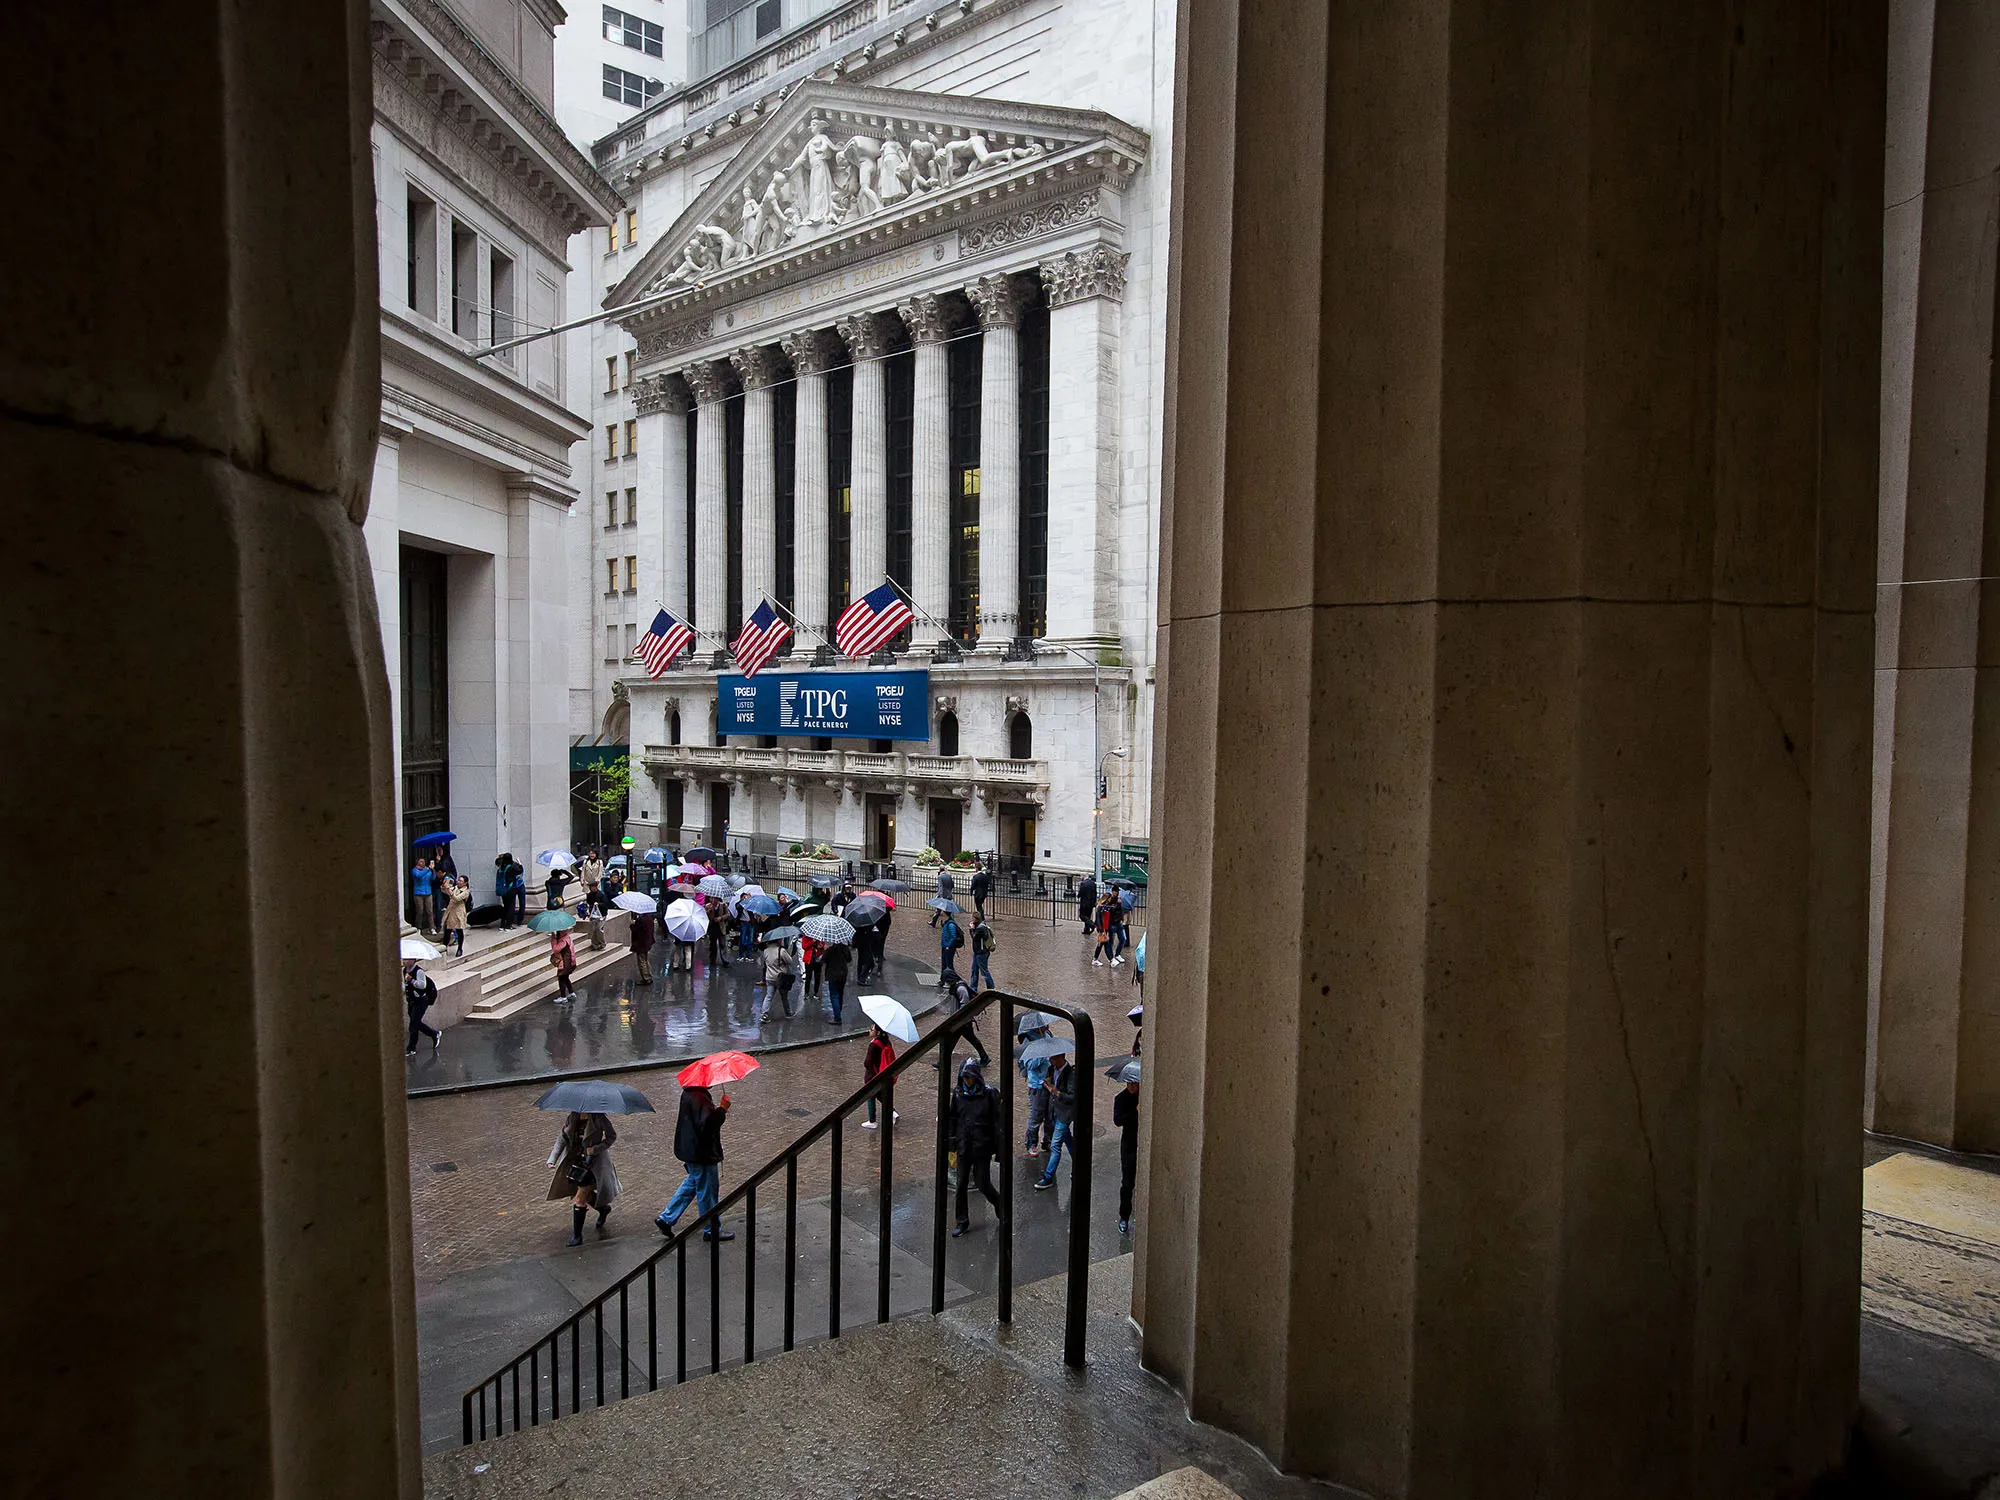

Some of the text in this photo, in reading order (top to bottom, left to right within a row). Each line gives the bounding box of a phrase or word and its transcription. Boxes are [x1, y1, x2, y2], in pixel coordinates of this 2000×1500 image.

[743, 252, 921, 321] NEW YORK STOCK EXCHANGE
[736, 701, 754, 709] LISTED
[801, 689, 848, 719] TPG
[878, 701, 901, 710] LISTED
[736, 713, 754, 723] NYSE
[879, 715, 902, 726] NYSE
[822, 721, 849, 729] ENERGY
[1125, 854, 1144, 862] Subway
